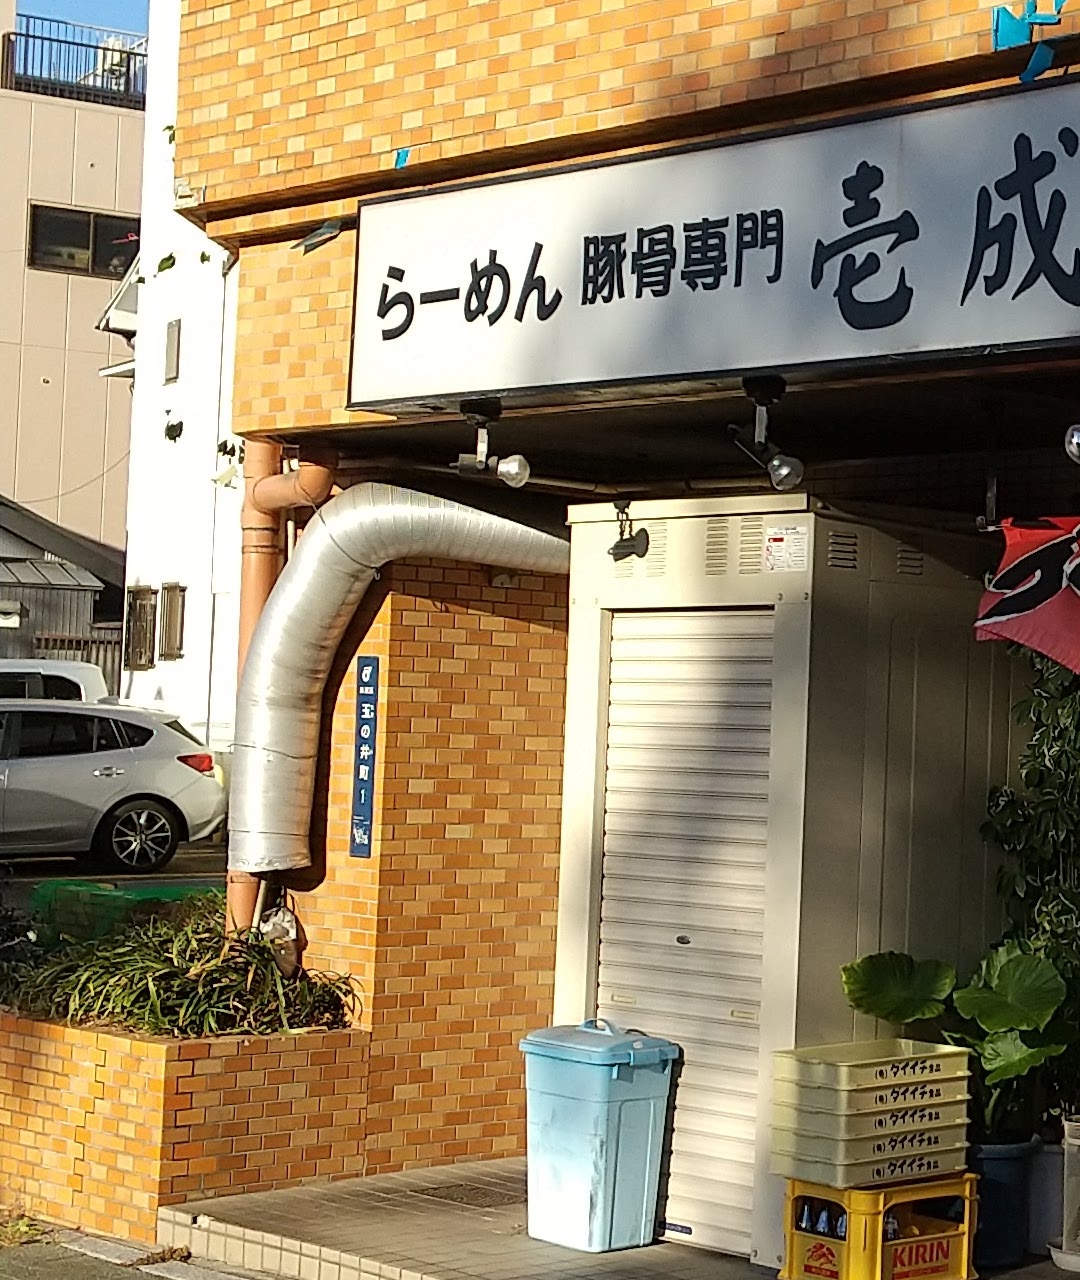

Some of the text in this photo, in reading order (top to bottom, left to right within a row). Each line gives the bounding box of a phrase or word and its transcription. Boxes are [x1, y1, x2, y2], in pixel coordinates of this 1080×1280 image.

[376, 241, 563, 341] らーめん
[580, 207, 785, 306] 豚骨専門
[892, 1240, 950, 1269] KIRIN
